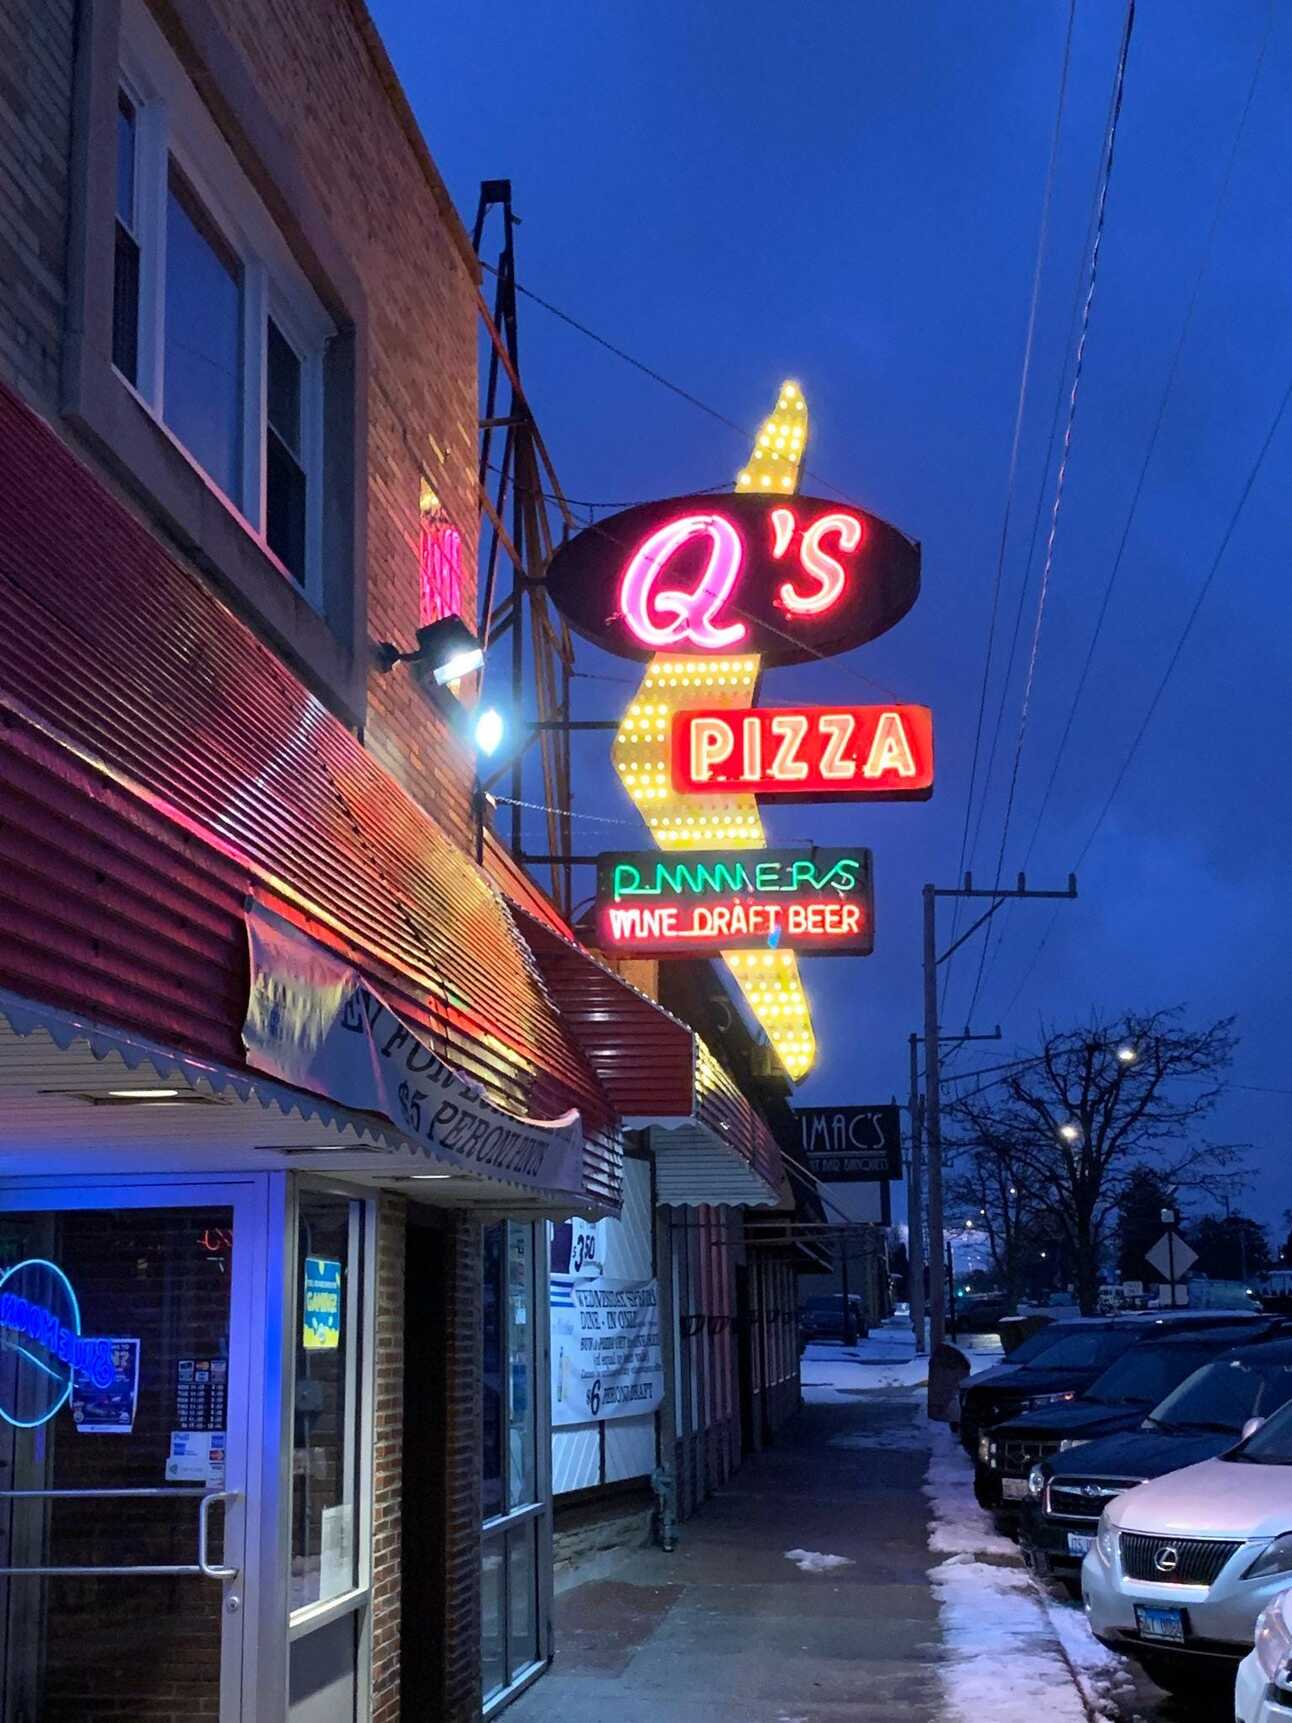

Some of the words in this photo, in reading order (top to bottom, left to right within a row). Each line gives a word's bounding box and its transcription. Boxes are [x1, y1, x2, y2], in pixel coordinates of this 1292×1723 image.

[618, 508, 864, 647] Q'S
[689, 712, 916, 782] PIZZA
[608, 908, 679, 940] WINE
[693, 904, 782, 936] DRAFT
[788, 903, 861, 934] BEER
[397, 1079, 429, 1134] $5
